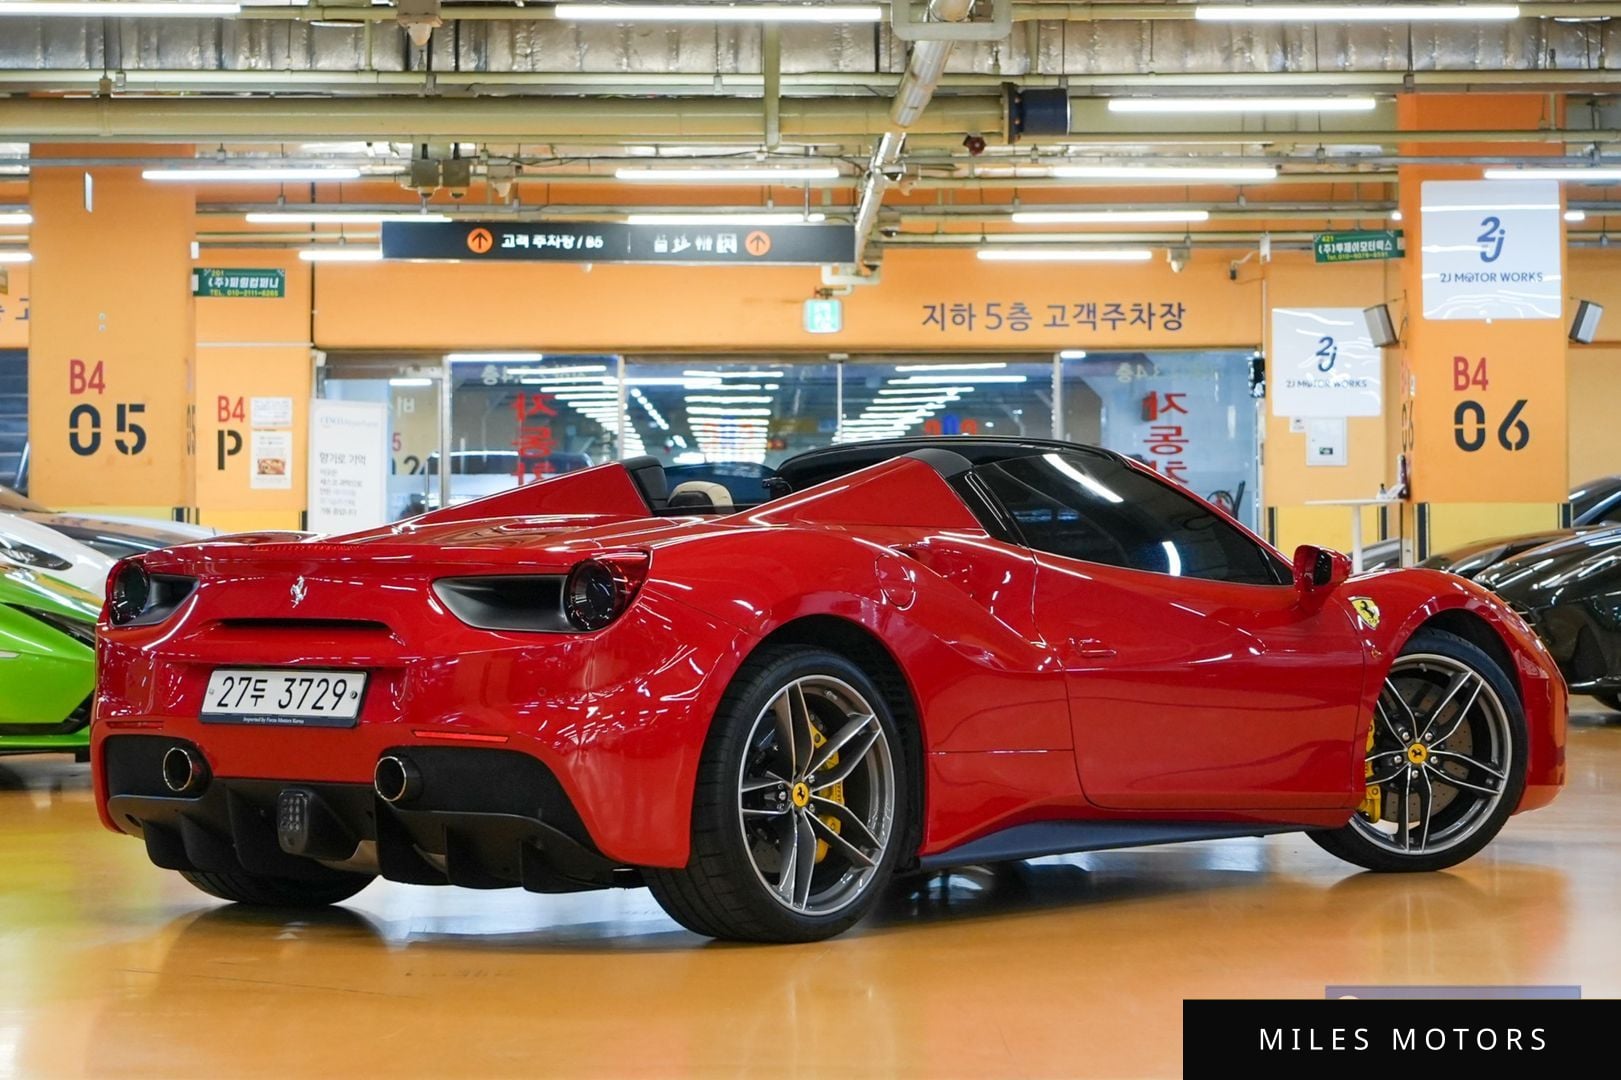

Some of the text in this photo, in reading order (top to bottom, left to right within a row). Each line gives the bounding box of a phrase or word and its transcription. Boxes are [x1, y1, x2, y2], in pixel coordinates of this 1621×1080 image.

[501, 233, 529, 249] 고객
[532, 233, 575, 250] 주차장
[1500, 271, 1544, 283] WORKS
[922, 301, 1187, 332] 지하 5층 고객주차장
[70, 359, 106, 395] B4
[1453, 356, 1489, 392] B4
[217, 395, 245, 422] B4
[1453, 399, 1529, 452] 06
[69, 403, 147, 456] 05
[217, 429, 242, 471] P
[216, 676, 348, 711] 27두 3729
